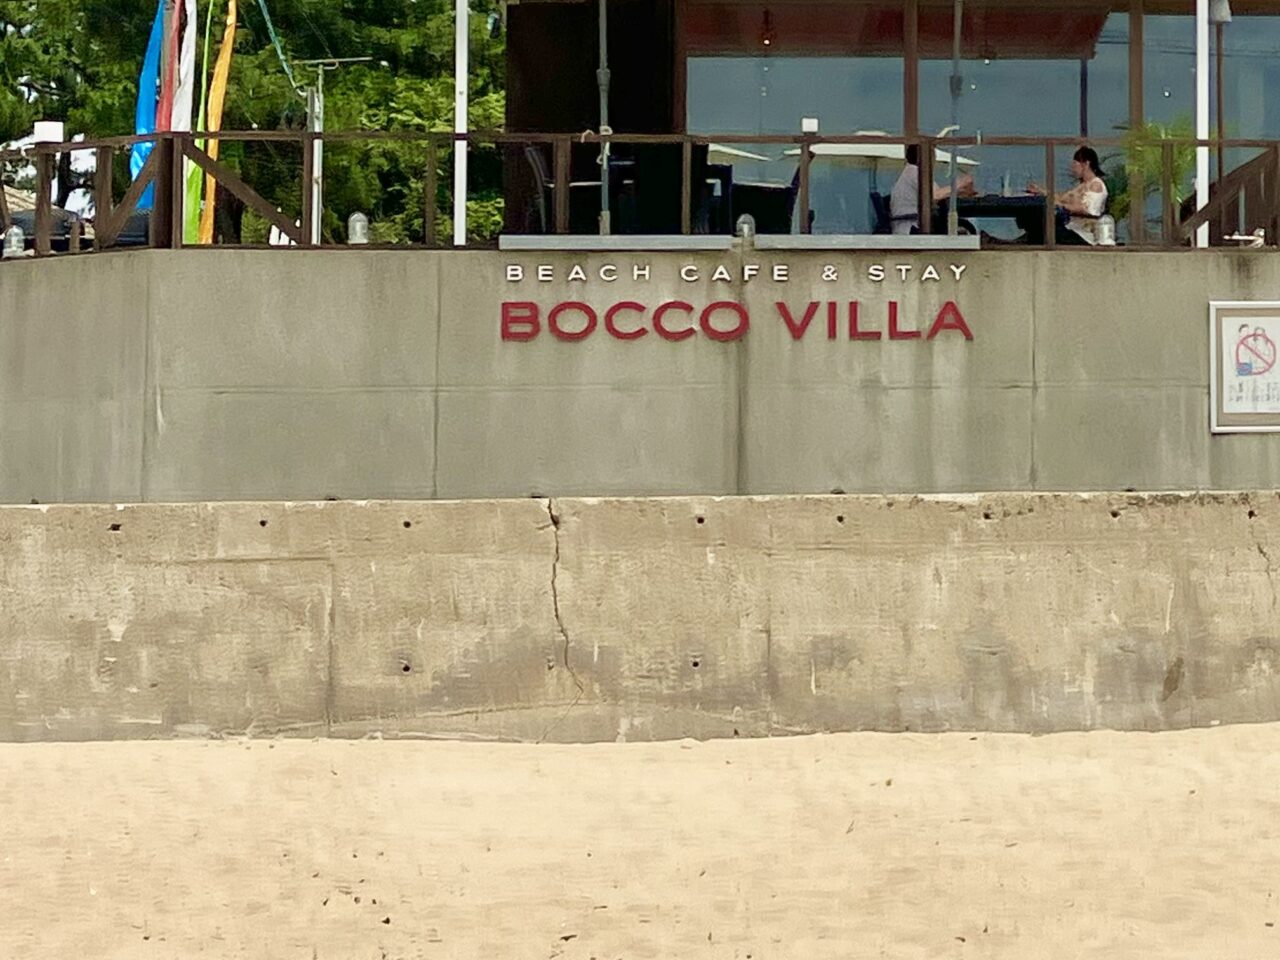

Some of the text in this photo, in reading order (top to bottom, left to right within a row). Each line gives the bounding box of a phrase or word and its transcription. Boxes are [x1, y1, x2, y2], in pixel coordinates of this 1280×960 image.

[505, 264, 968, 282] BEACH CAFE & STAY
[501, 301, 974, 341] BOCCO VILLA
